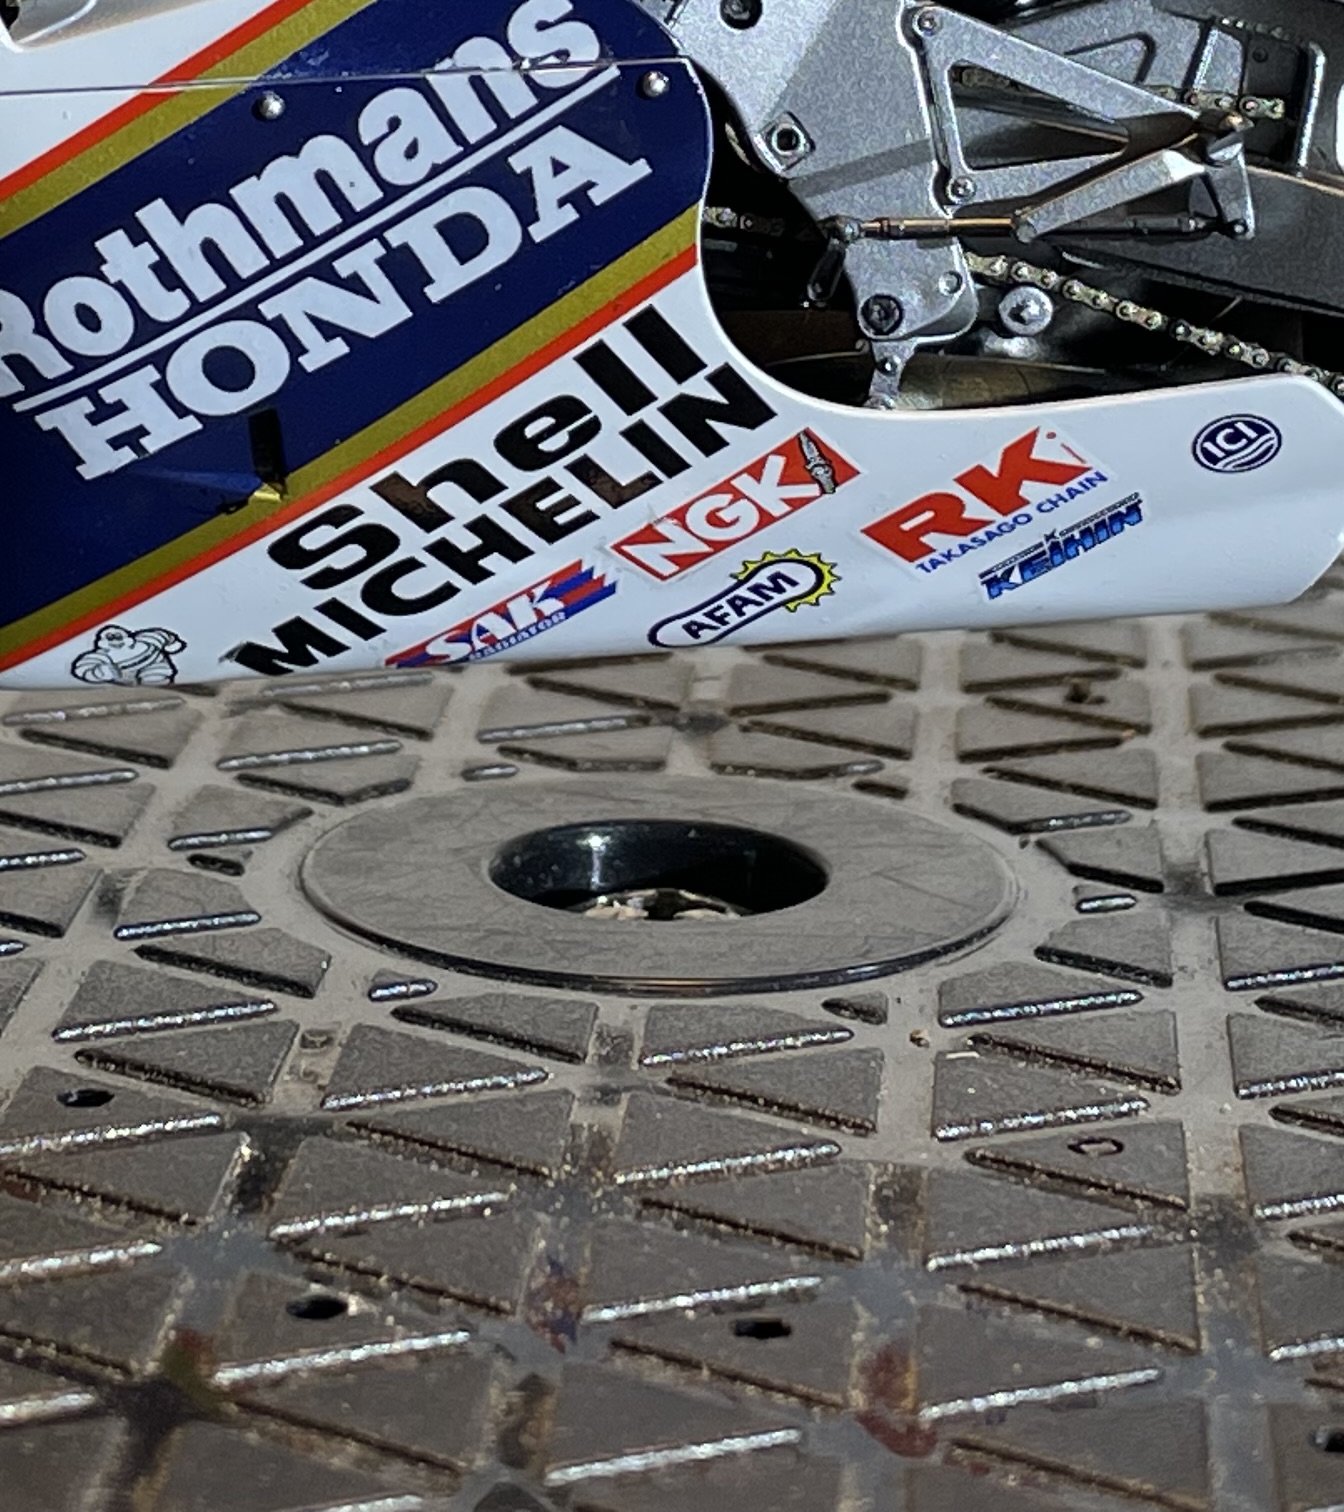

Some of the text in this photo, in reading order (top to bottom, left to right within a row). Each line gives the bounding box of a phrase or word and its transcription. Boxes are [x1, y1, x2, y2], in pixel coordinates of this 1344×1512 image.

[34, 123, 653, 481] HONDA
[267, 303, 708, 590] Shell
[860, 425, 1094, 564] RK
[1202, 421, 1259, 458] ICI
[234, 362, 778, 676] MICHELIN
[620, 453, 822, 575] NGK
[915, 512, 1034, 575] TAKASAGO
[1035, 469, 1109, 515] CHAIN
[980, 498, 1144, 601] KEIHIN
[425, 579, 566, 663] SAK
[681, 570, 800, 640] AFAM
